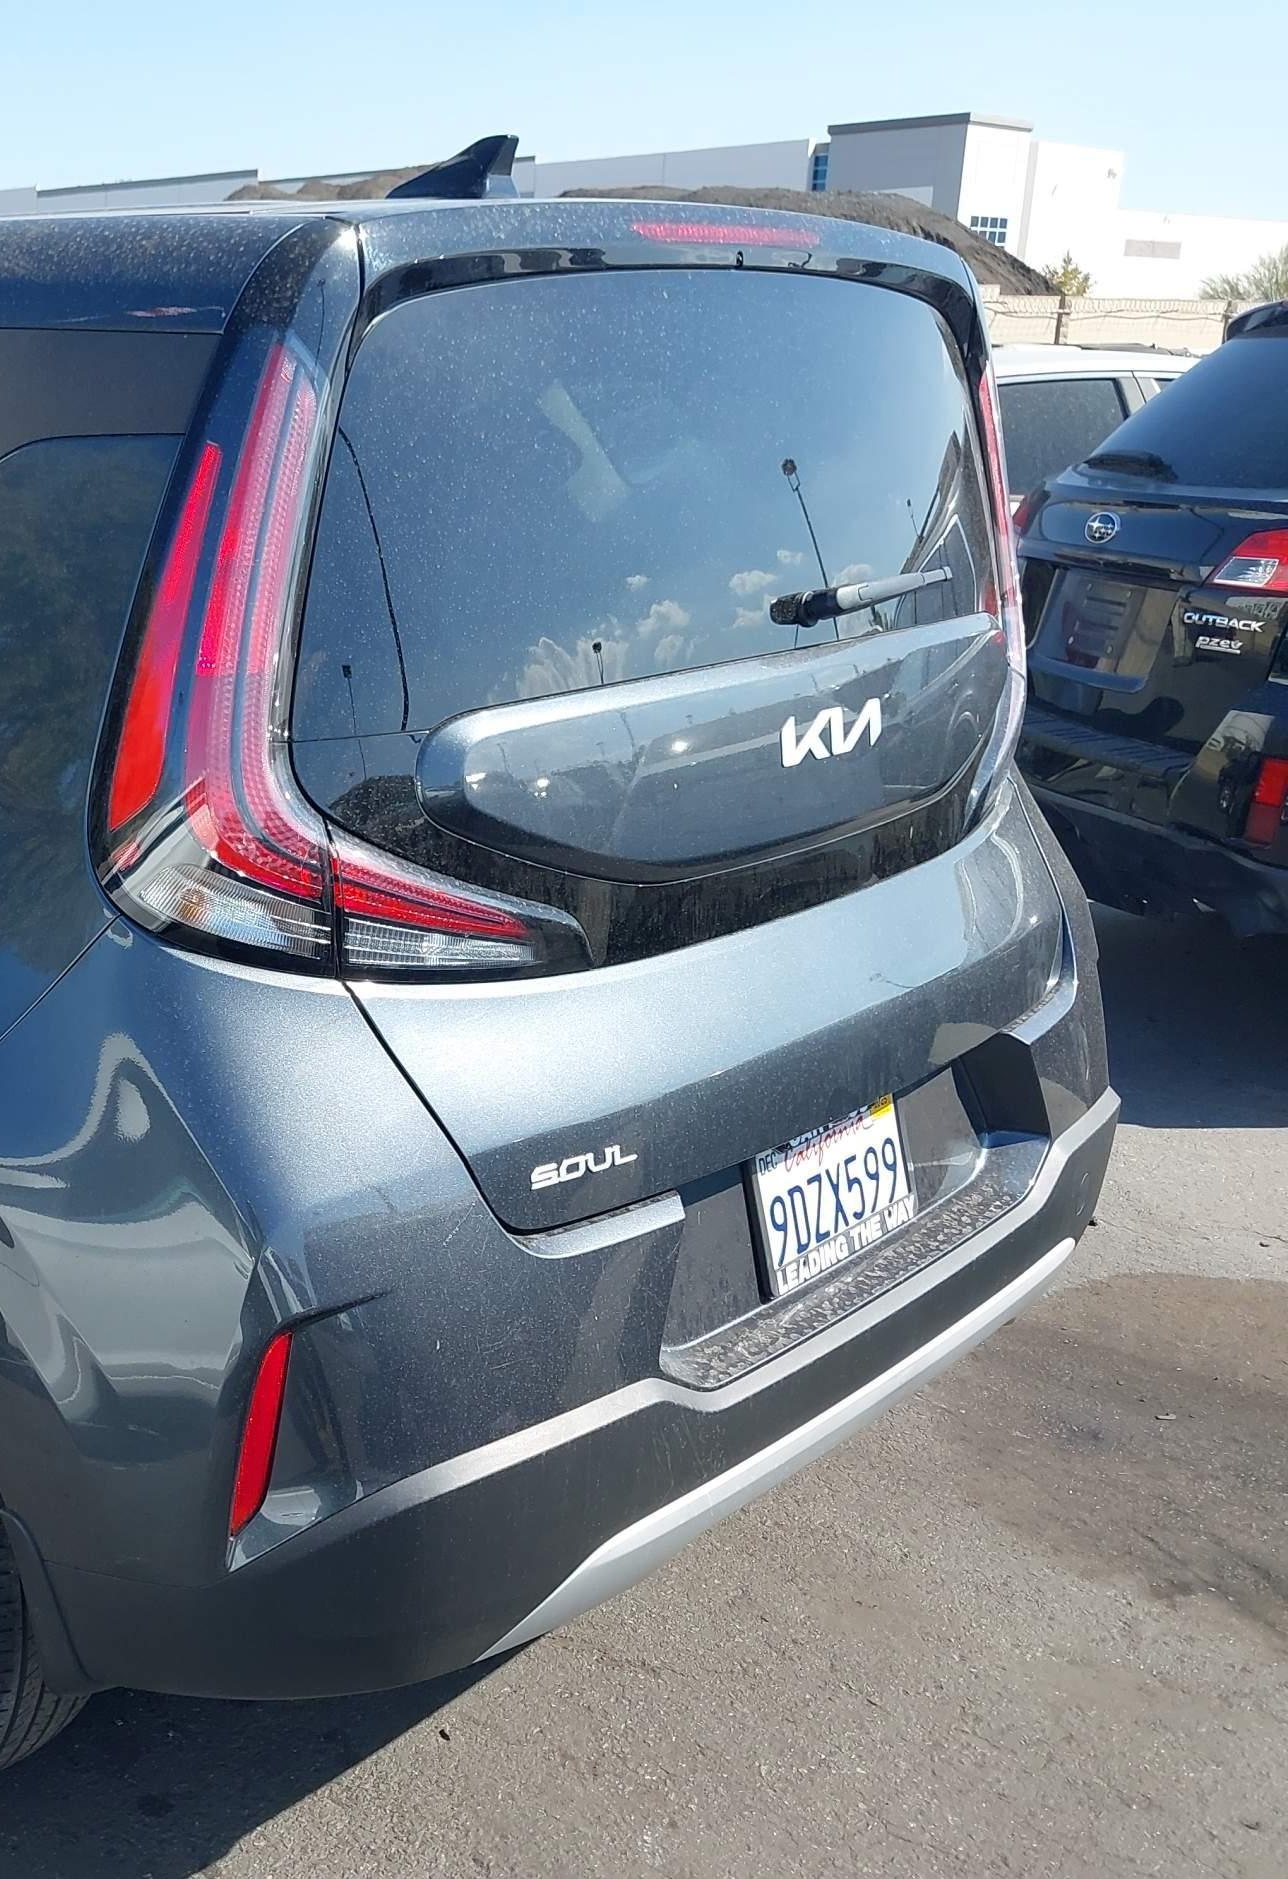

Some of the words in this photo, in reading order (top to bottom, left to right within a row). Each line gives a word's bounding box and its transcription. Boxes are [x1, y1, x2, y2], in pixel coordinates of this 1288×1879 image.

[1183, 612, 1267, 633] OUTBACK
[530, 1144, 639, 1191] SOUL
[758, 1151, 778, 1176] DEC
[770, 1137, 897, 1267] 9DZX599
[776, 1234, 850, 1296] LEADING
[848, 1213, 883, 1251] THE
[883, 1194, 915, 1233] WAY
